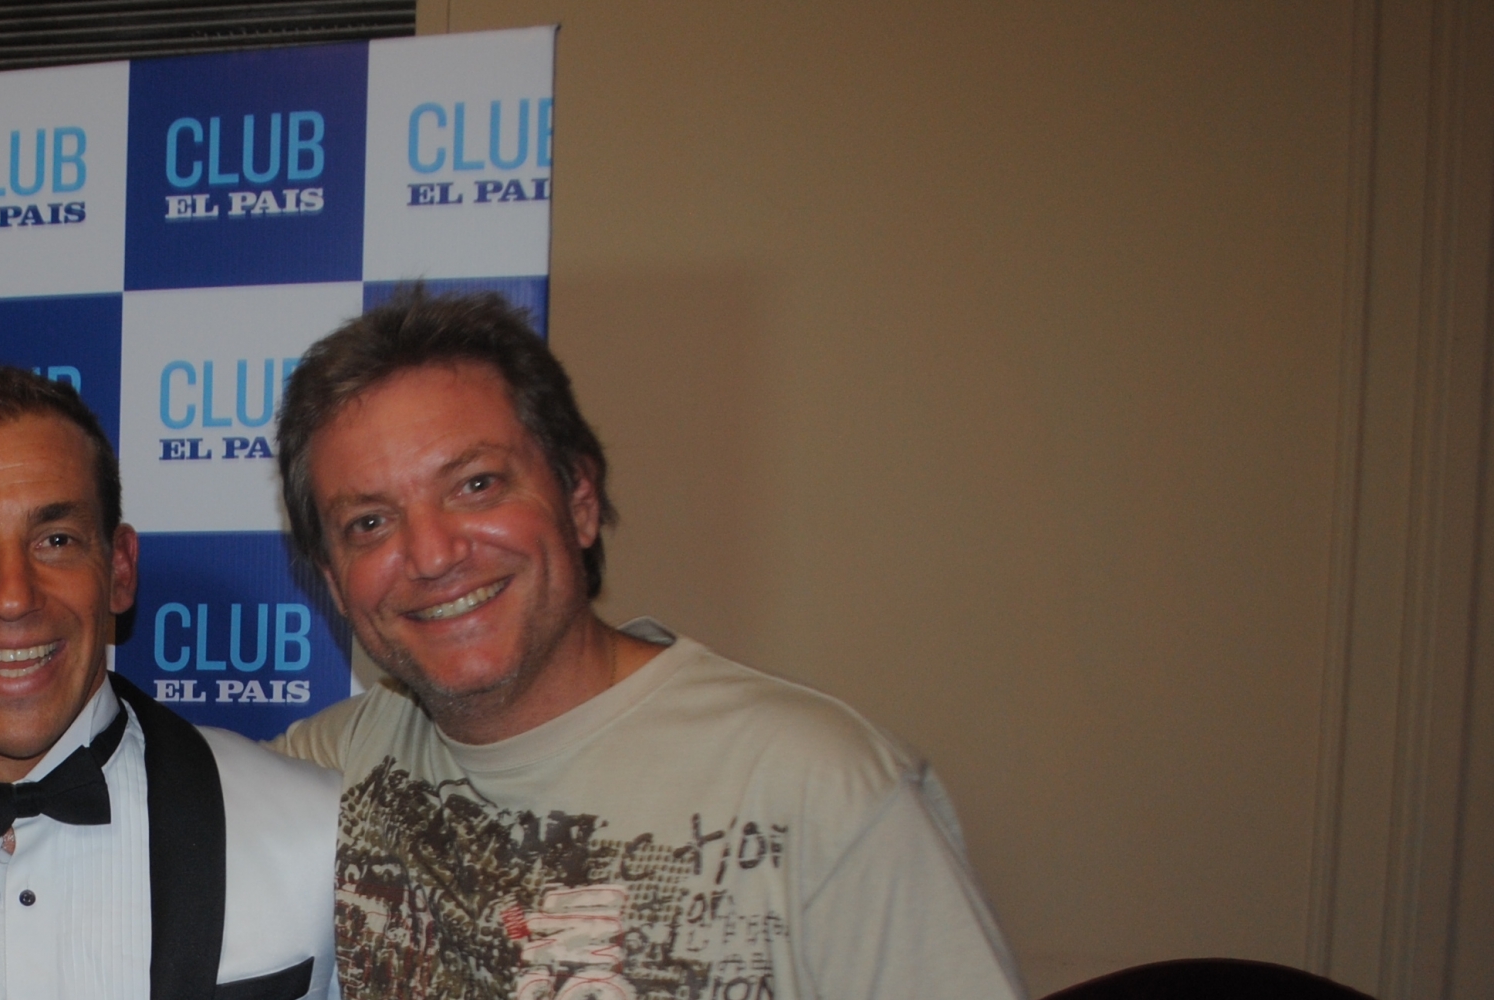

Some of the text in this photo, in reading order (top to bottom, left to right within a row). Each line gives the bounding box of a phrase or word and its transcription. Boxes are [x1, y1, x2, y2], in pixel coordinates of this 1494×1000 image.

[165, 110, 325, 188] CLUB
[165, 188, 324, 219] EL PAIS
[407, 178, 549, 206] EL PAI
[159, 438, 212, 460] EL
[154, 602, 311, 672] CLUB
[153, 679, 310, 703] EL PAIS
